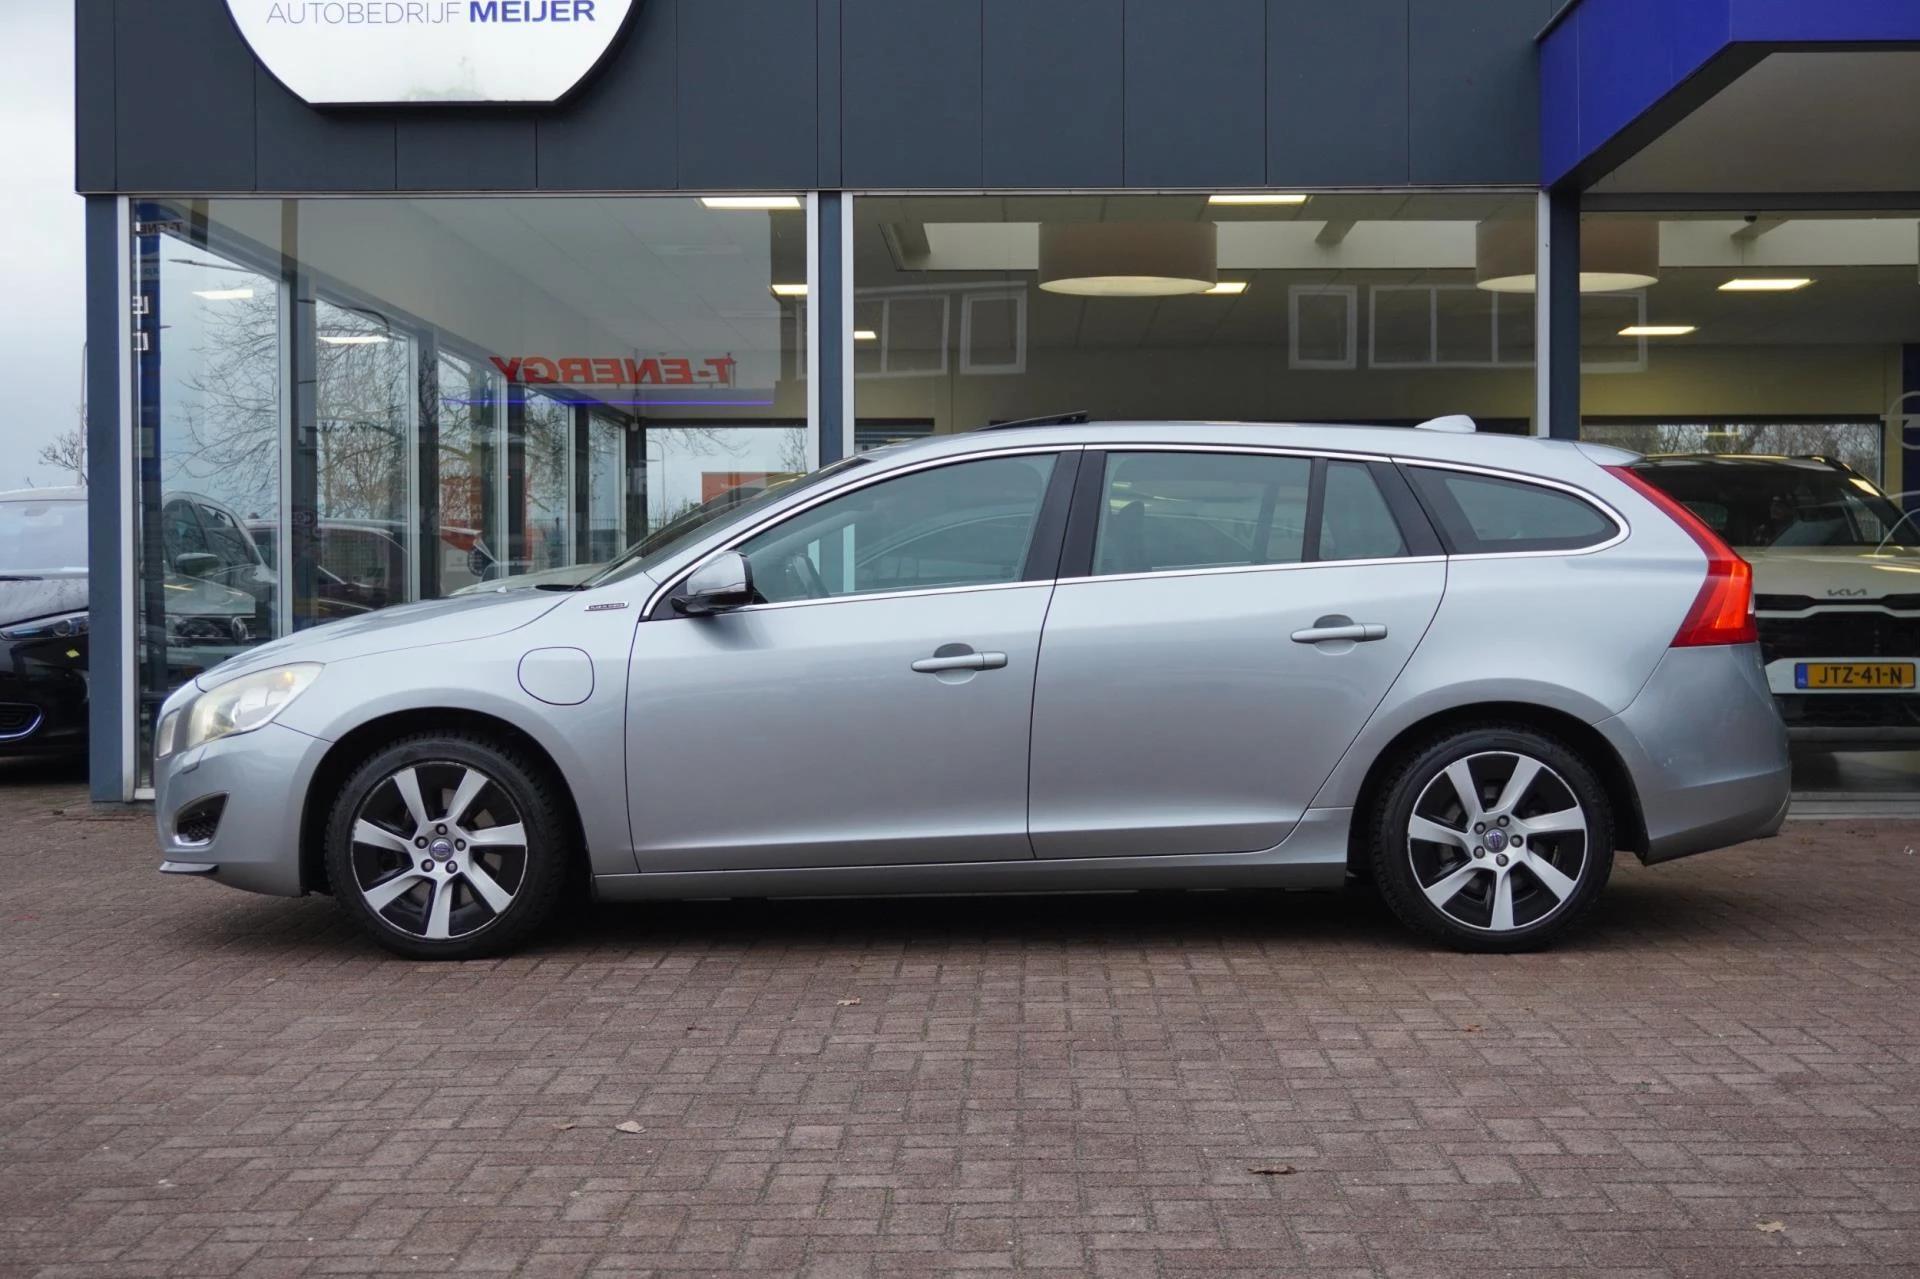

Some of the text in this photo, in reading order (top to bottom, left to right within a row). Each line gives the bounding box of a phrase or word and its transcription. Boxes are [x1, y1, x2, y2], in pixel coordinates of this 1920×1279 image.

[266, 0, 596, 24] AUTOBEDRIJF MEIJER
[1819, 666, 1902, 684] JTZ-41-N
